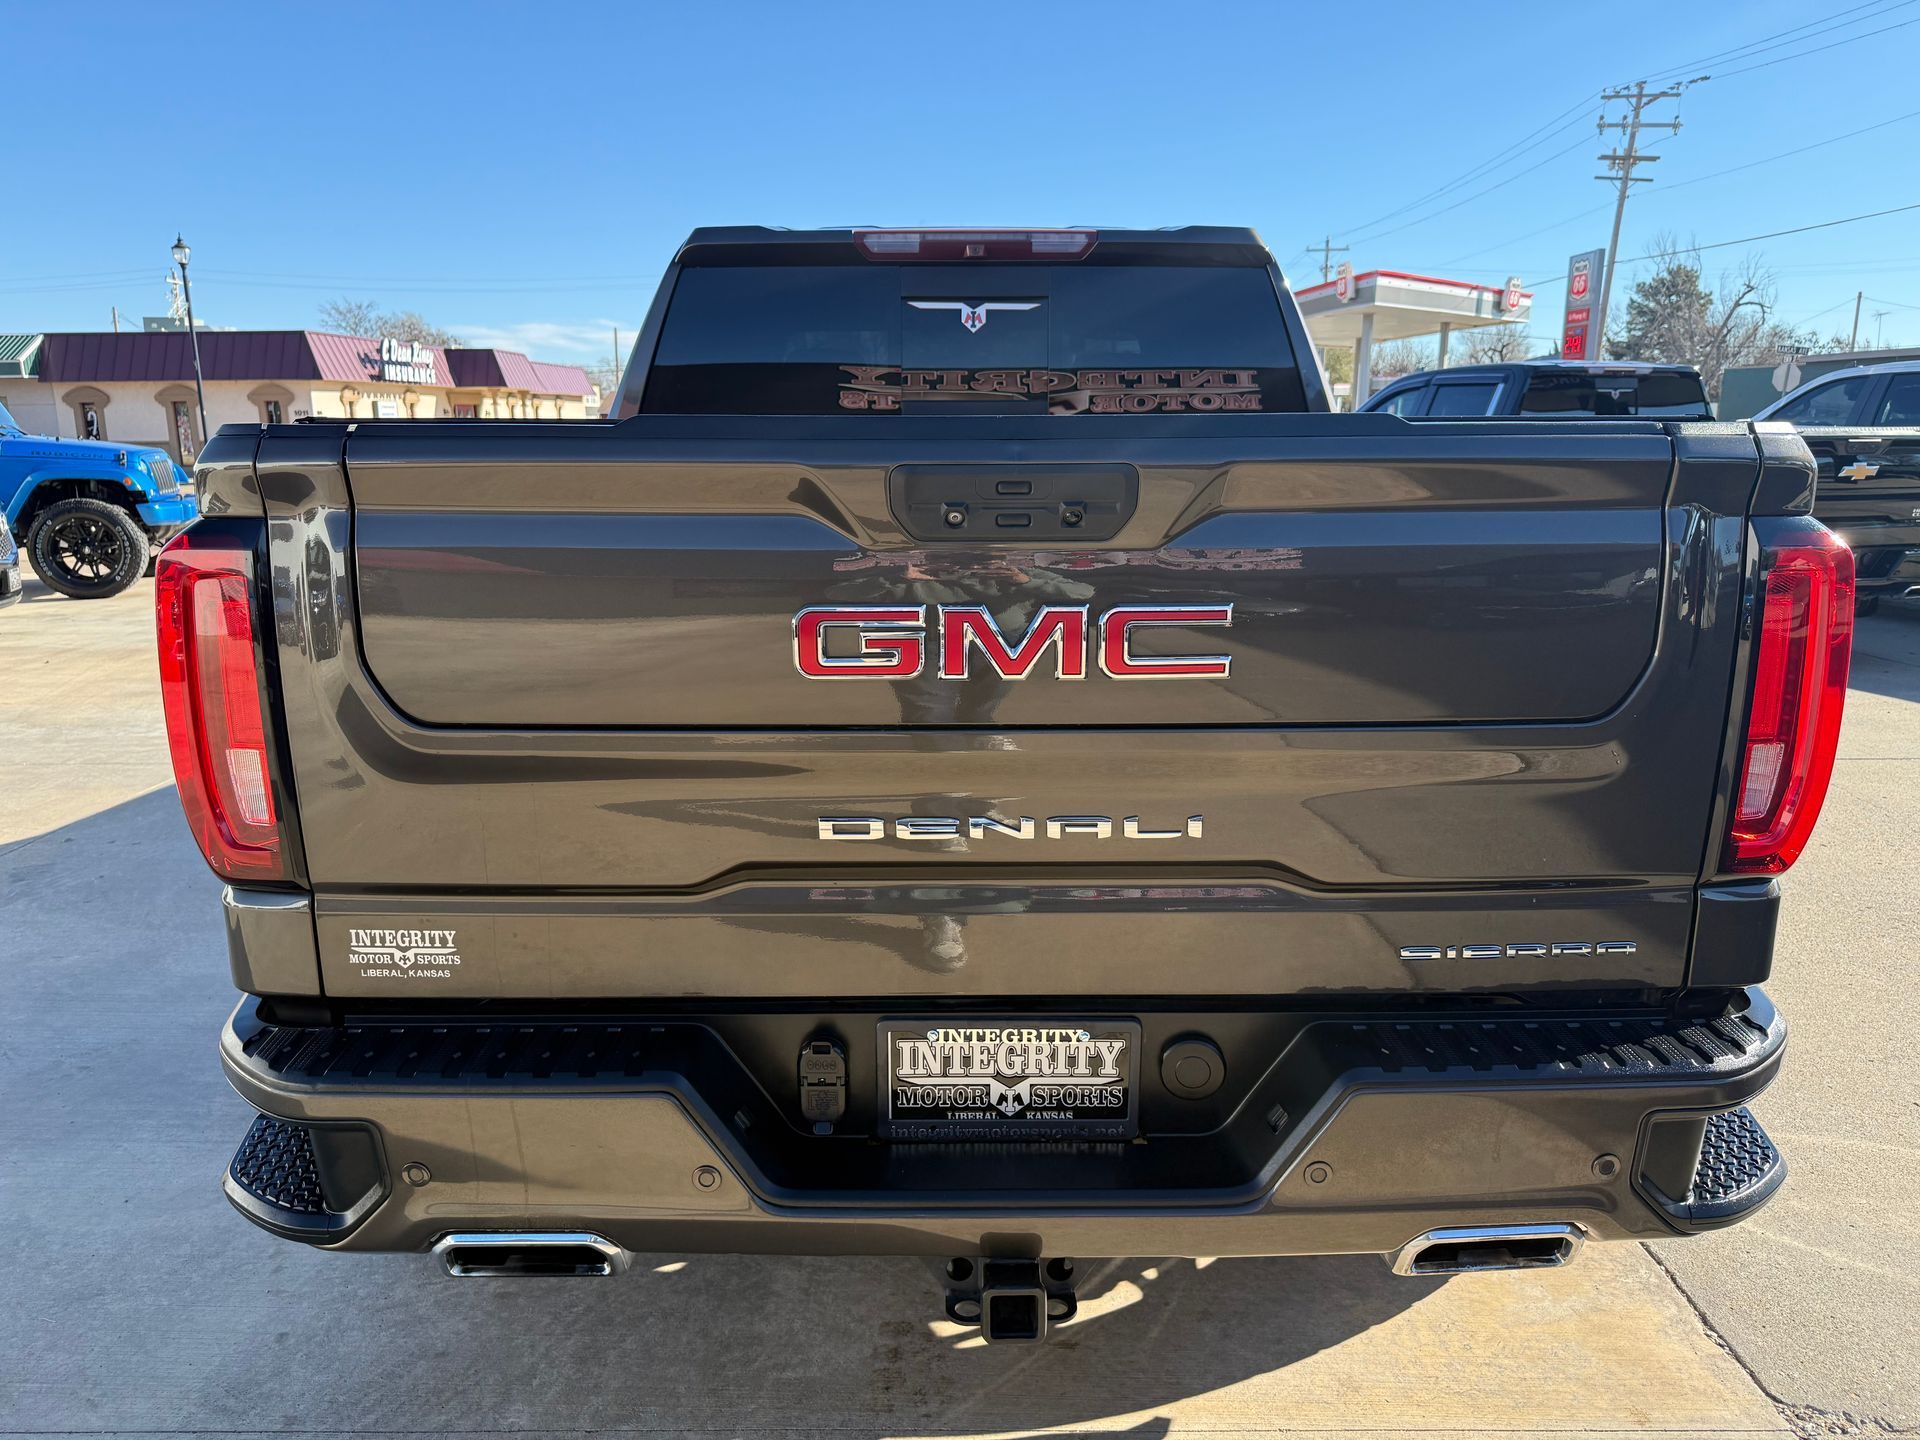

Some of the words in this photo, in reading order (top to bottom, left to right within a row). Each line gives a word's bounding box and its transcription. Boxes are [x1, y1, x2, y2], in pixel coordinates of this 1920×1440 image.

[1573, 275, 1586, 294] 66
[384, 364, 436, 384] INSURANCE
[791, 603, 1234, 681] GMC
[818, 815, 1204, 840] DENALI
[349, 929, 456, 947] INTEGRITY
[349, 954, 393, 964] MOTOR
[417, 954, 461, 965] SPORTS
[1400, 941, 1637, 960] SIERRA
[361, 969, 407, 978] LIBERAL,
[409, 969, 451, 978] KANSAS
[937, 1028, 1083, 1044] INTEGRITY
[896, 1040, 1125, 1077] INTEGRITY
[897, 1085, 990, 1108] MOTOR
[1031, 1085, 1123, 1108] SPORTS
